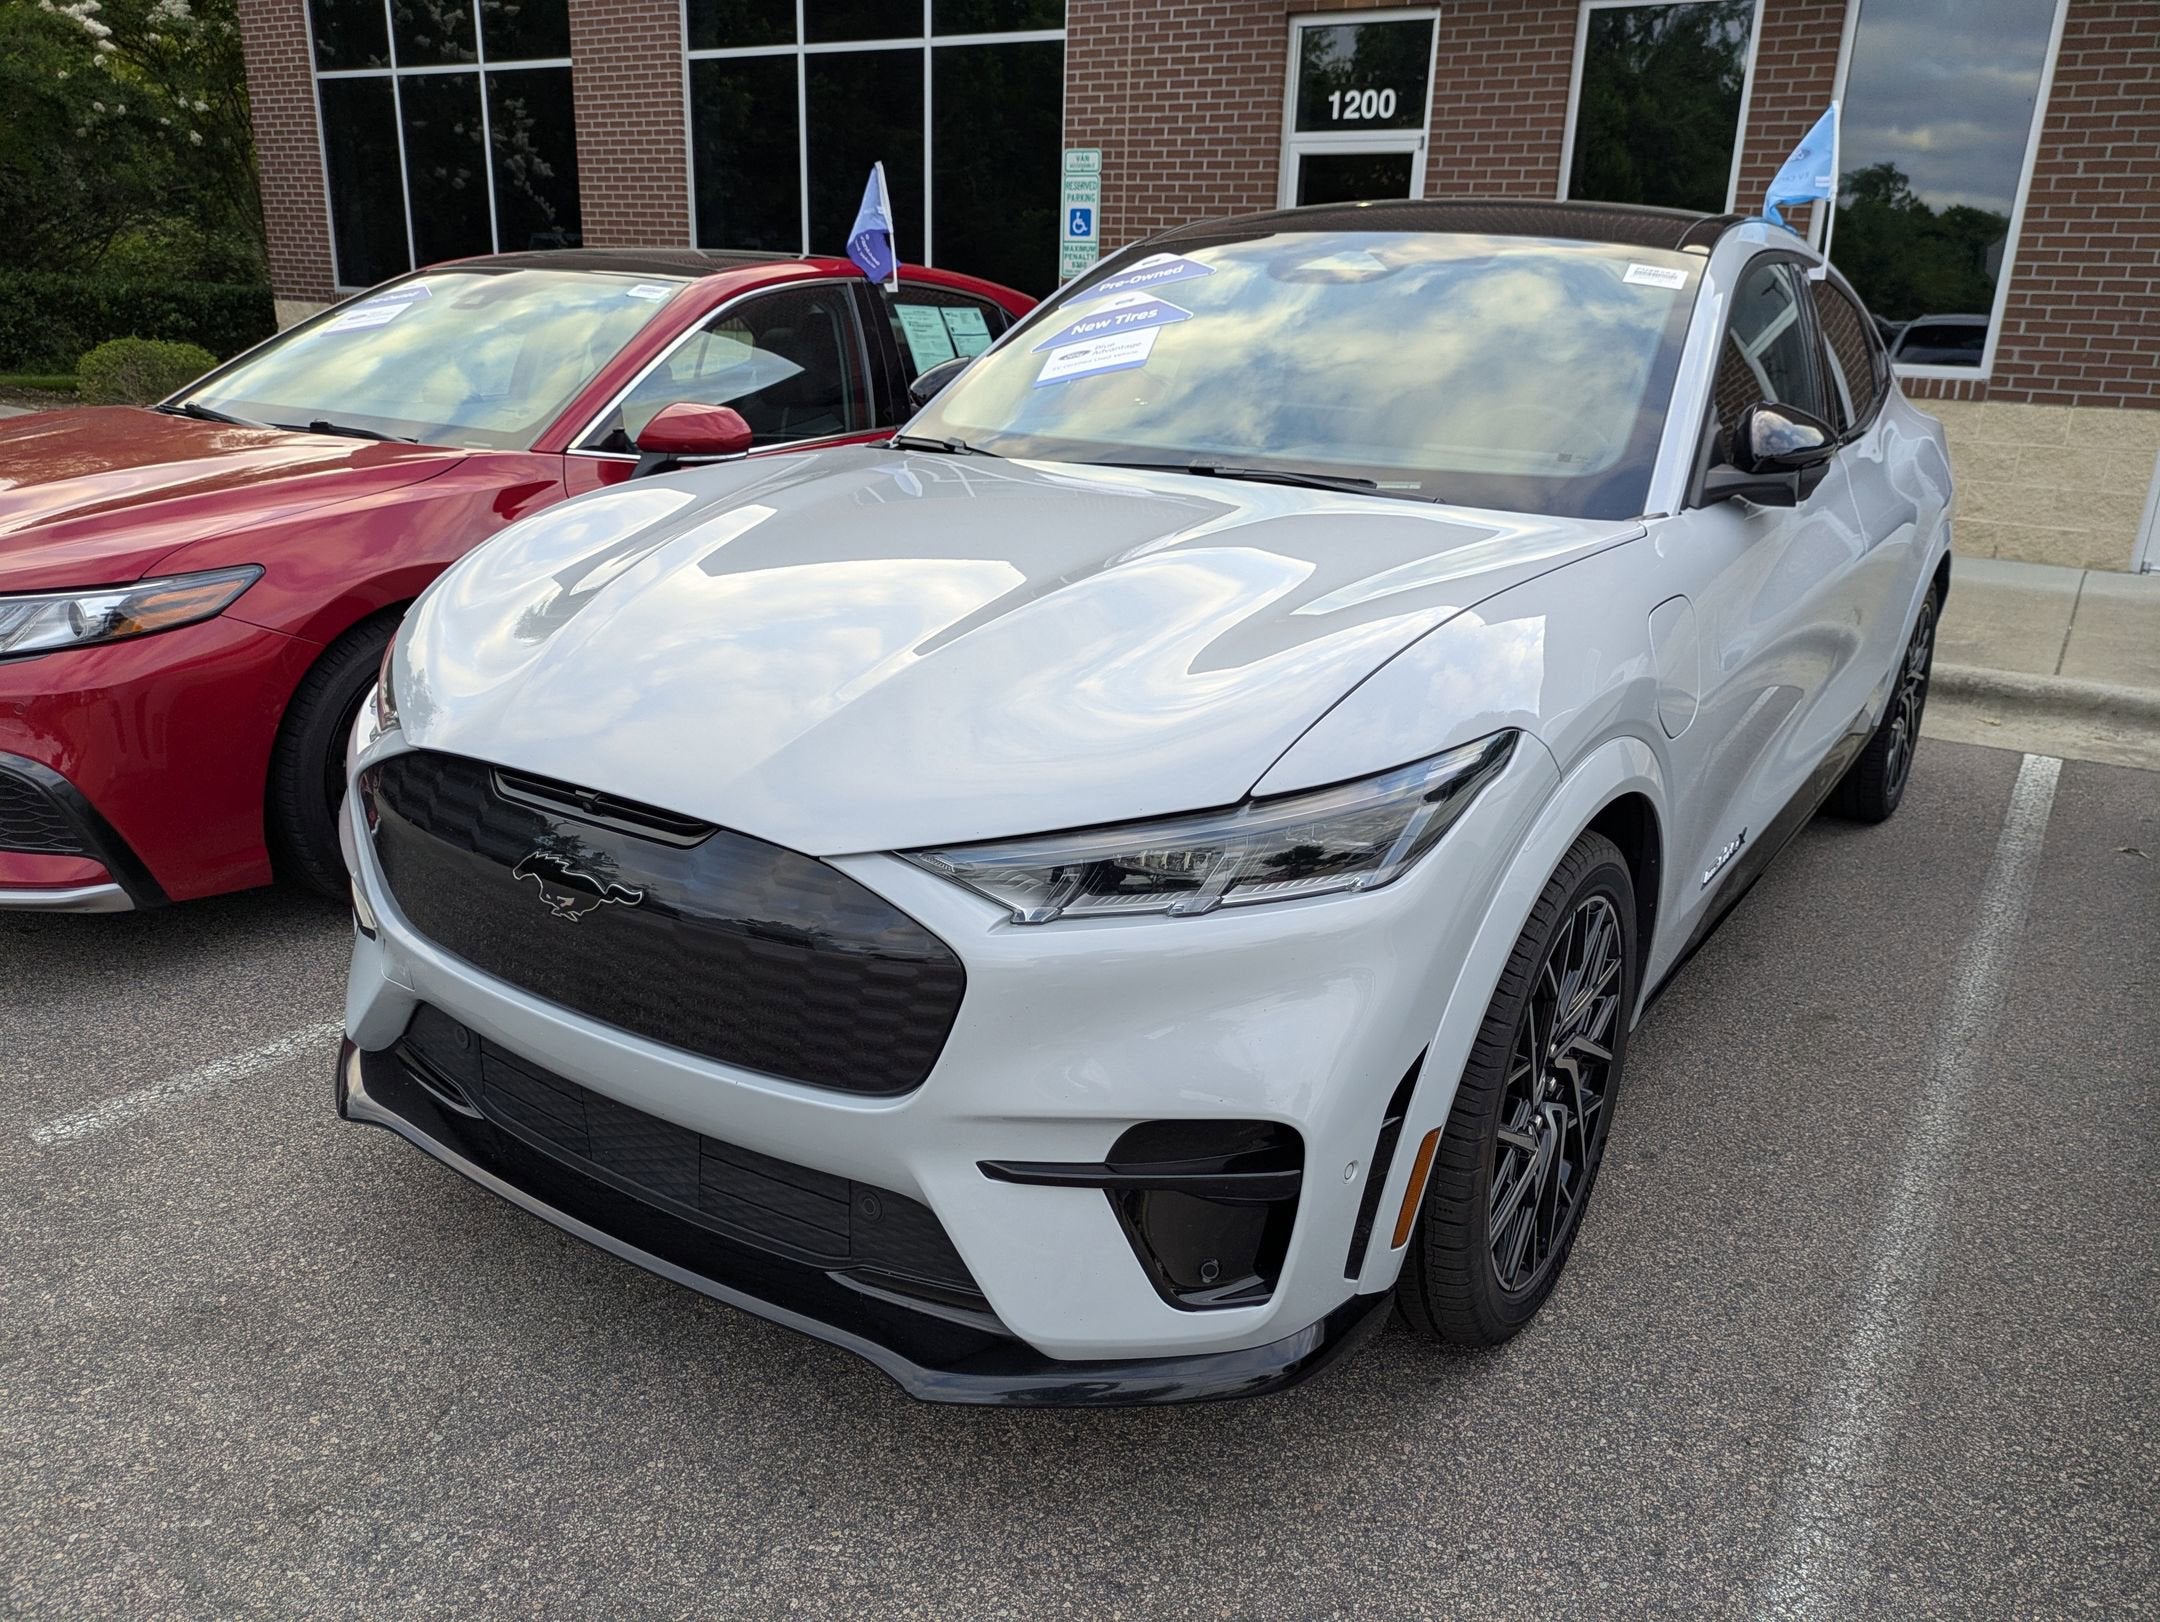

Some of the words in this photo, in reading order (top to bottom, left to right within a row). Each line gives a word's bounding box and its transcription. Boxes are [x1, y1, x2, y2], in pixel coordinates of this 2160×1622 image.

[1328, 88, 1397, 120] 1200
[1066, 181, 1098, 191] RESERVED
[1066, 193, 1096, 203] PARKING
[1064, 253, 1095, 261] PENALTY
[1098, 264, 1185, 292] Pre-Owned
[1070, 318, 1111, 336] New
[1115, 308, 1159, 325] Tires
